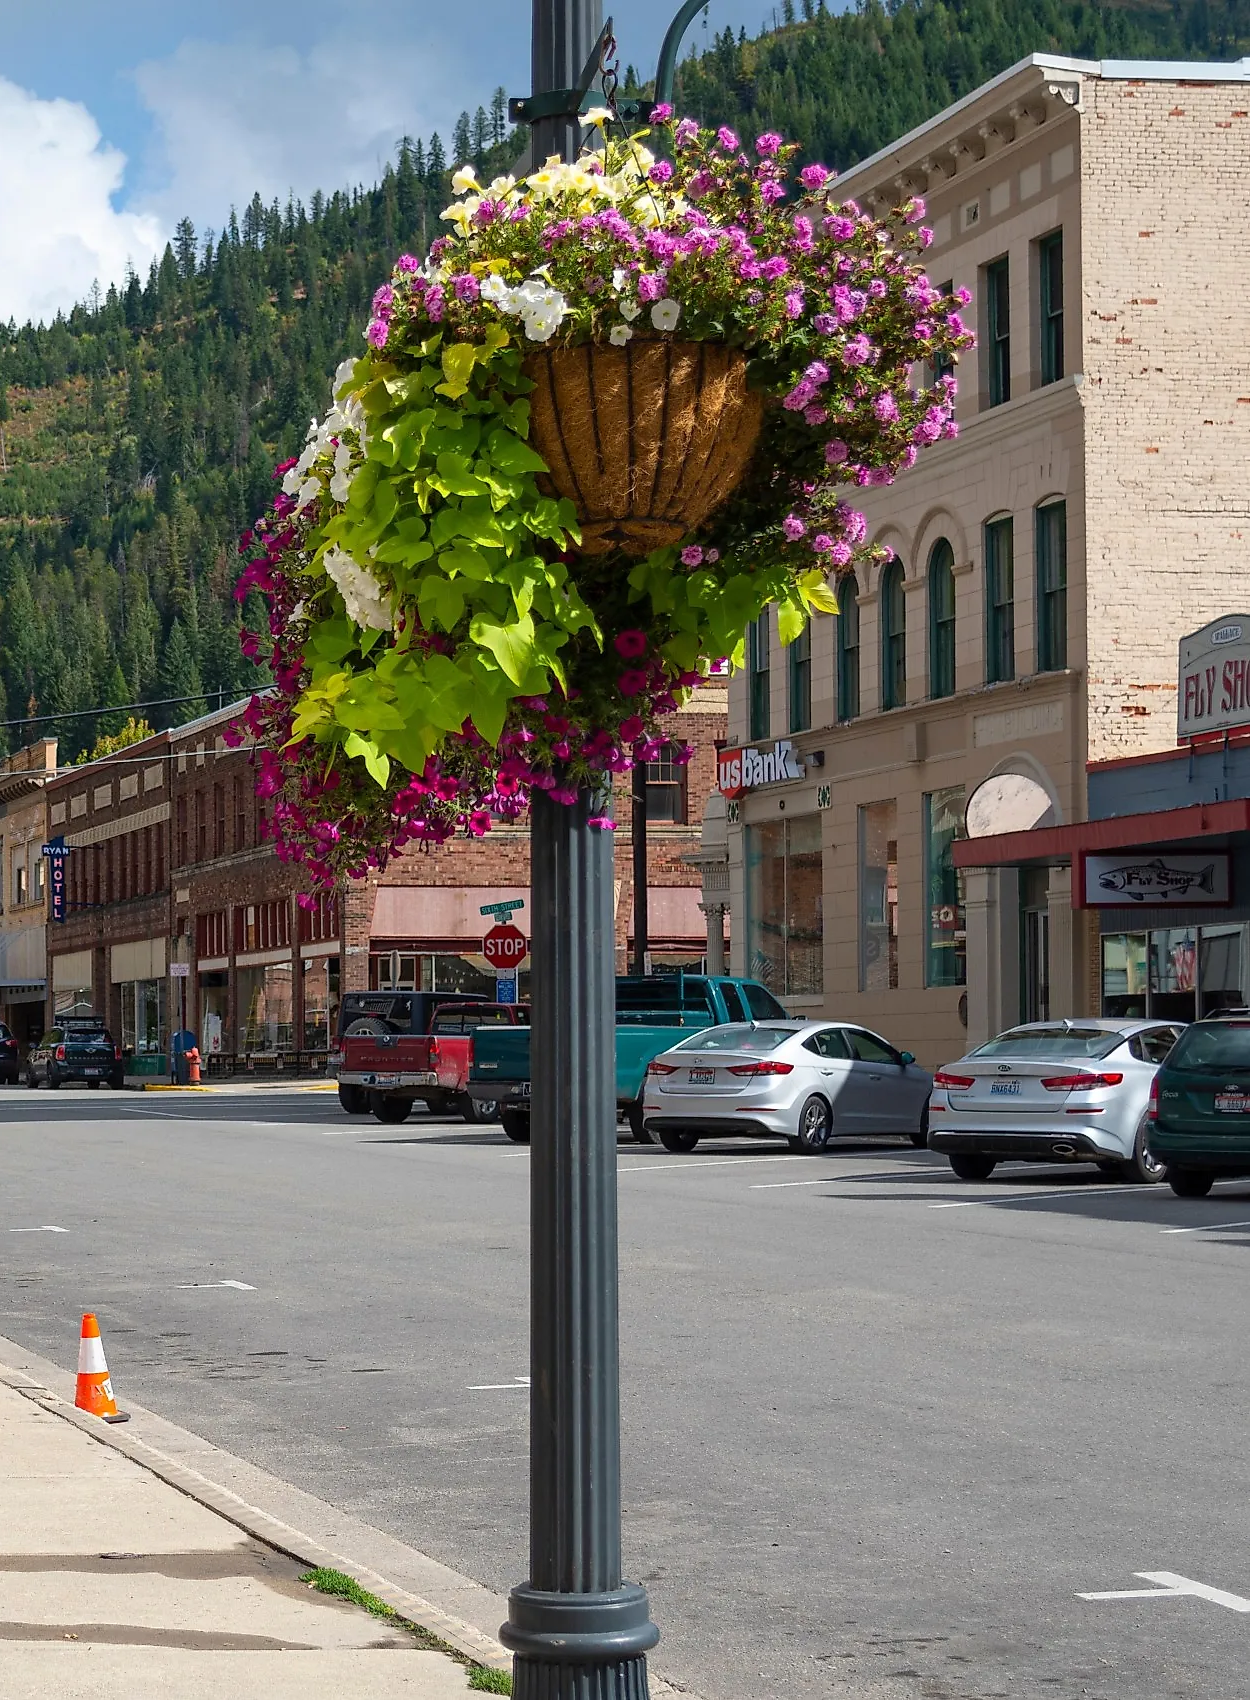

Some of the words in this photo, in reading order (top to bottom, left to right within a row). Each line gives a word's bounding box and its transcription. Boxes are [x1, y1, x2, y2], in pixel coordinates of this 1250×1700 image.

[1183, 665, 1217, 721] FLY
[1221, 660, 1250, 713] SH
[43, 847, 69, 855] RYAN
[53, 858, 63, 918] HOTEL
[481, 904, 499, 914] SIXTH
[501, 901, 523, 911] STREET
[485, 938, 524, 956] STOP
